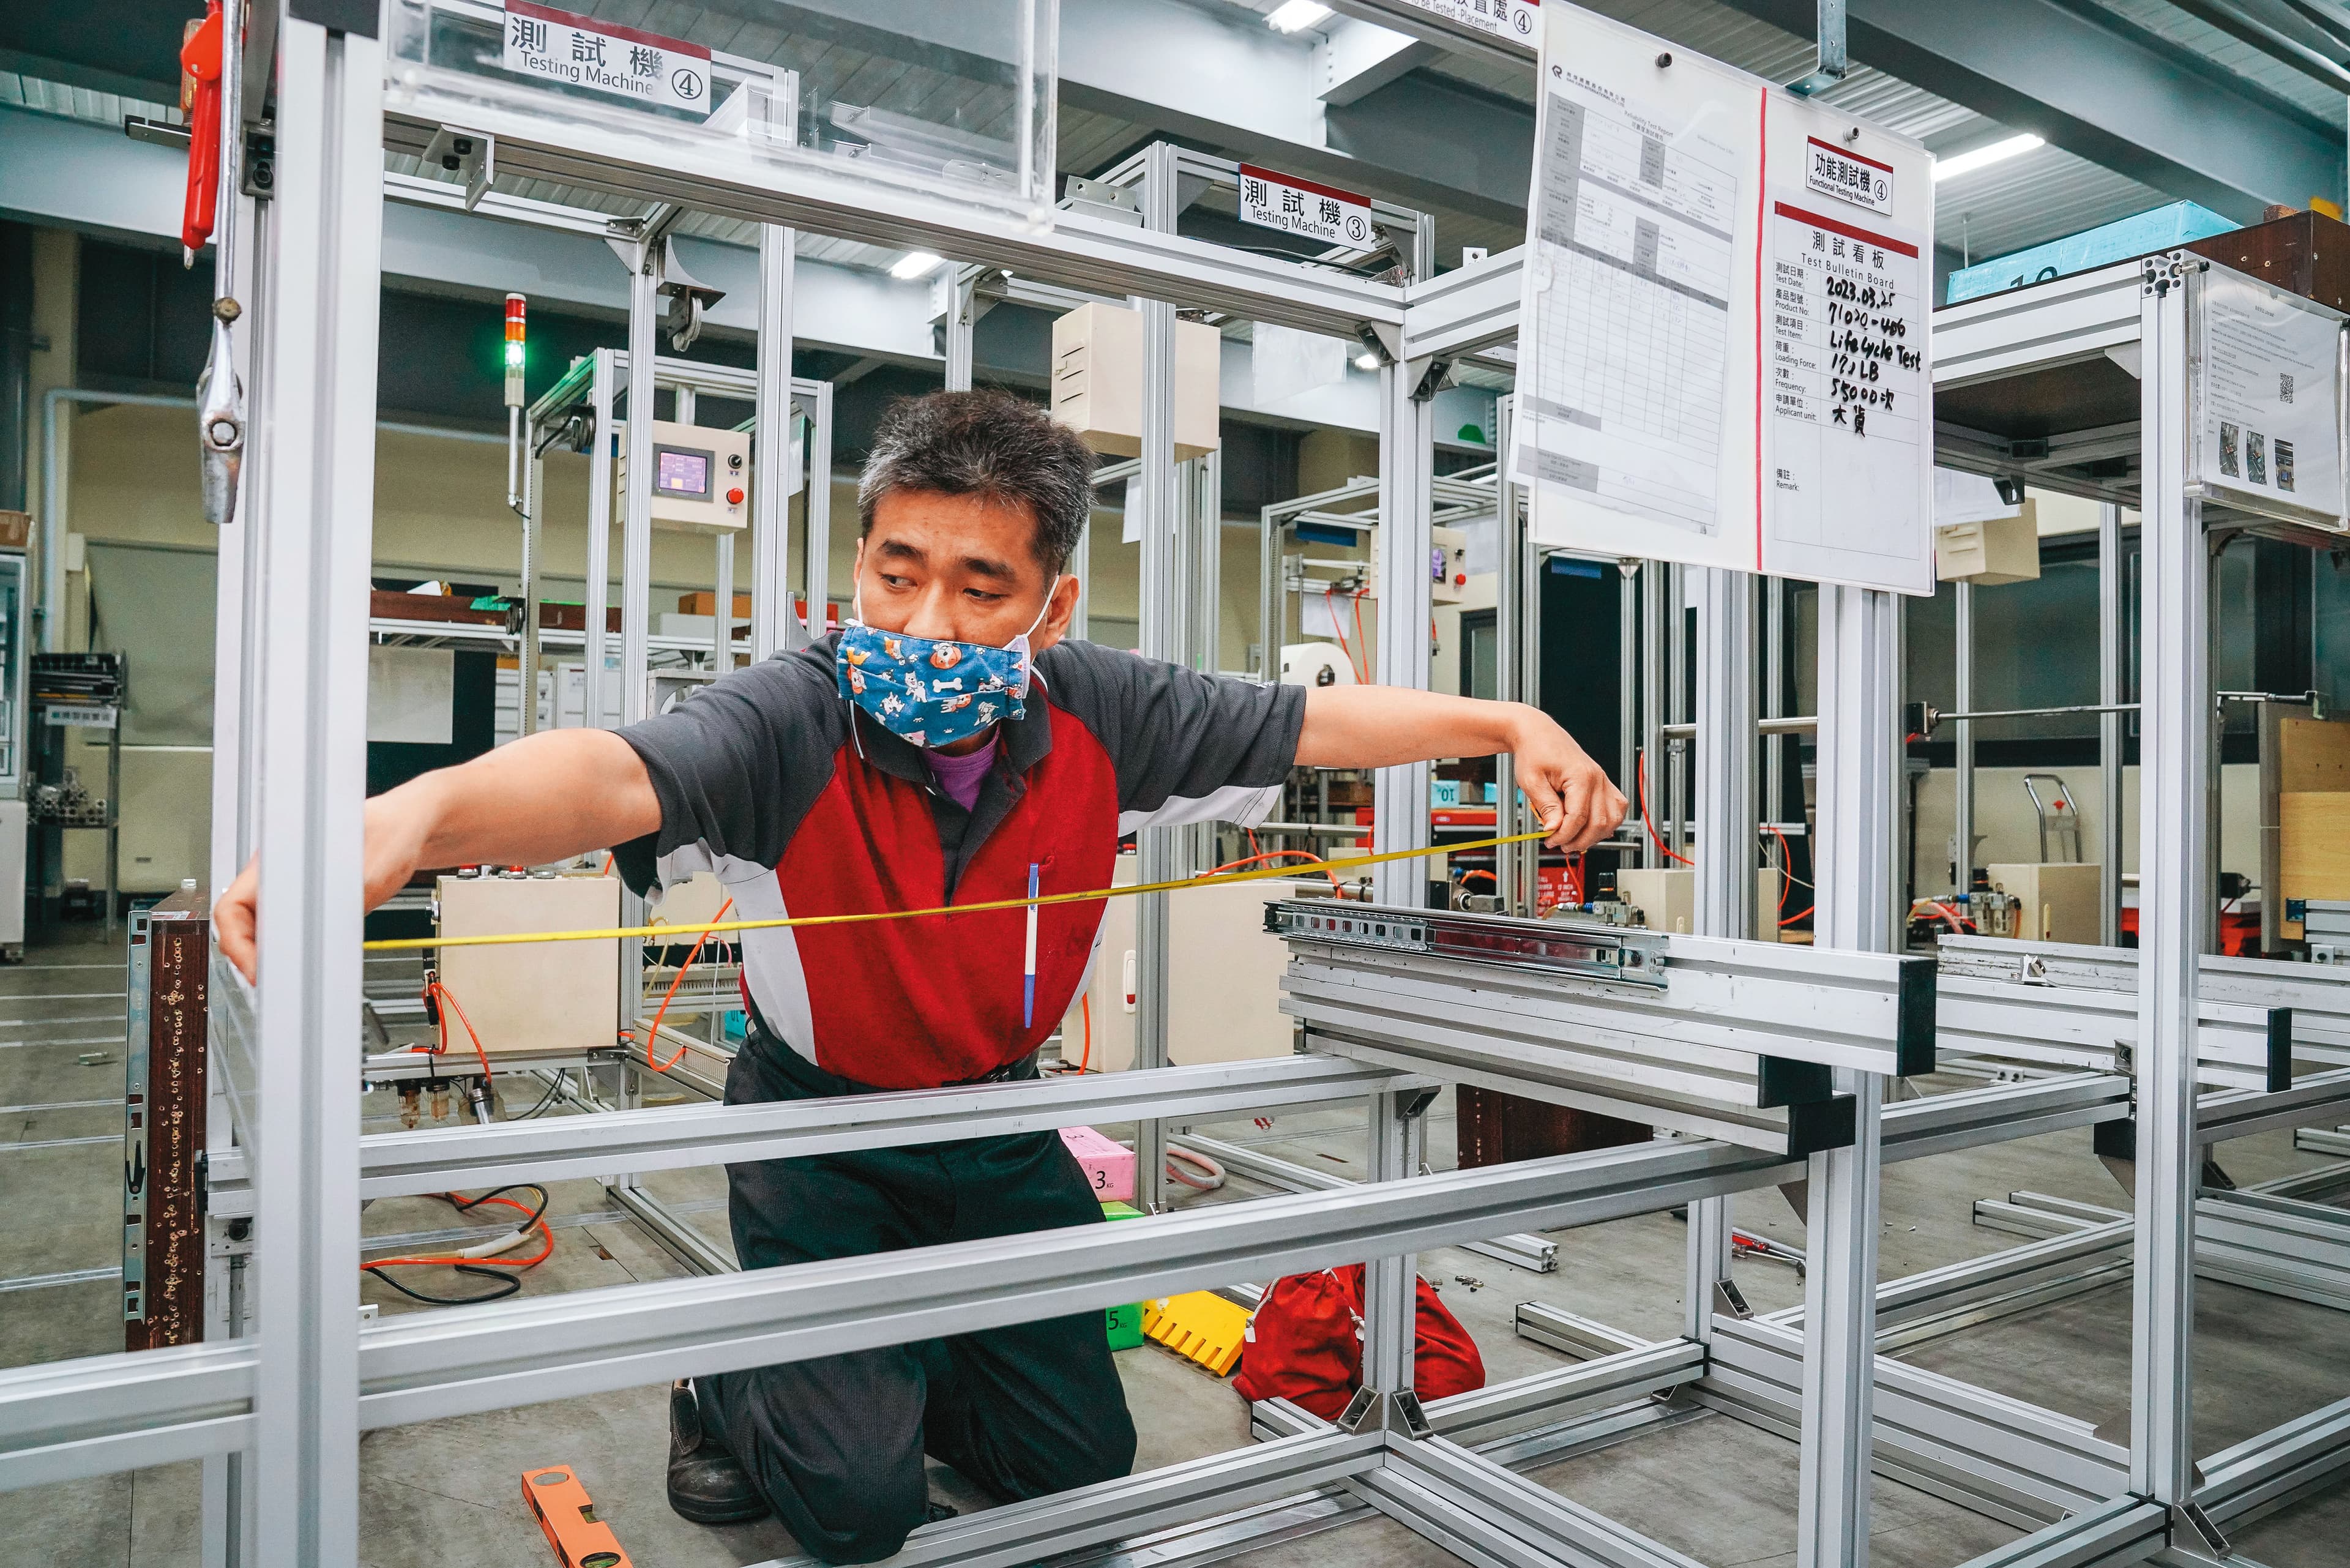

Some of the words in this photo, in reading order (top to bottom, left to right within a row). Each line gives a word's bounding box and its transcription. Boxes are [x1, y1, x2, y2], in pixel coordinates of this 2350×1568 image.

[1433, 1, 1455, 17] Tested
[511, 16, 663, 80] 測試機
[521, 50, 580, 83] Testing
[586, 65, 654, 96] Machine
[1624, 110, 1647, 127] Reliability
[1647, 121, 1657, 130] Test
[1658, 126, 1674, 138] Report
[1815, 153, 1870, 193] 功能測試機
[1244, 178, 1341, 226] 測試機
[1809, 175, 1835, 192] Functional
[1835, 185, 1853, 201] Testing
[1854, 191, 1875, 206] Machine
[1251, 205, 1288, 230] Testing
[1292, 215, 1335, 238] Machine
[1812, 230, 1884, 271] 測試看板
[1775, 273, 1787, 284] Test
[1801, 252, 1822, 269] Test
[1826, 260, 1863, 281] Bulletin
[1868, 272, 1894, 289] Board
[1826, 276, 1896, 310] 2023.03.25
[1775, 299, 1798, 313] Product
[1775, 326, 1787, 336] Test
[1788, 329, 1802, 340] Item:
[1775, 352, 1798, 367] Loading
[1799, 358, 1817, 370] Force:
[1830, 329, 1859, 354] Life
[1861, 335, 1893, 361] Cycle
[1896, 344, 1922, 372] Test
[1860, 360, 1879, 382] LB
[1775, 378, 1807, 394] Frequency:
[1775, 405, 1803, 418] Applicant
[1777, 479, 1800, 492] Remark:
[1095, 1170, 1106, 1190] 3
[1108, 1310, 1119, 1331] 5
